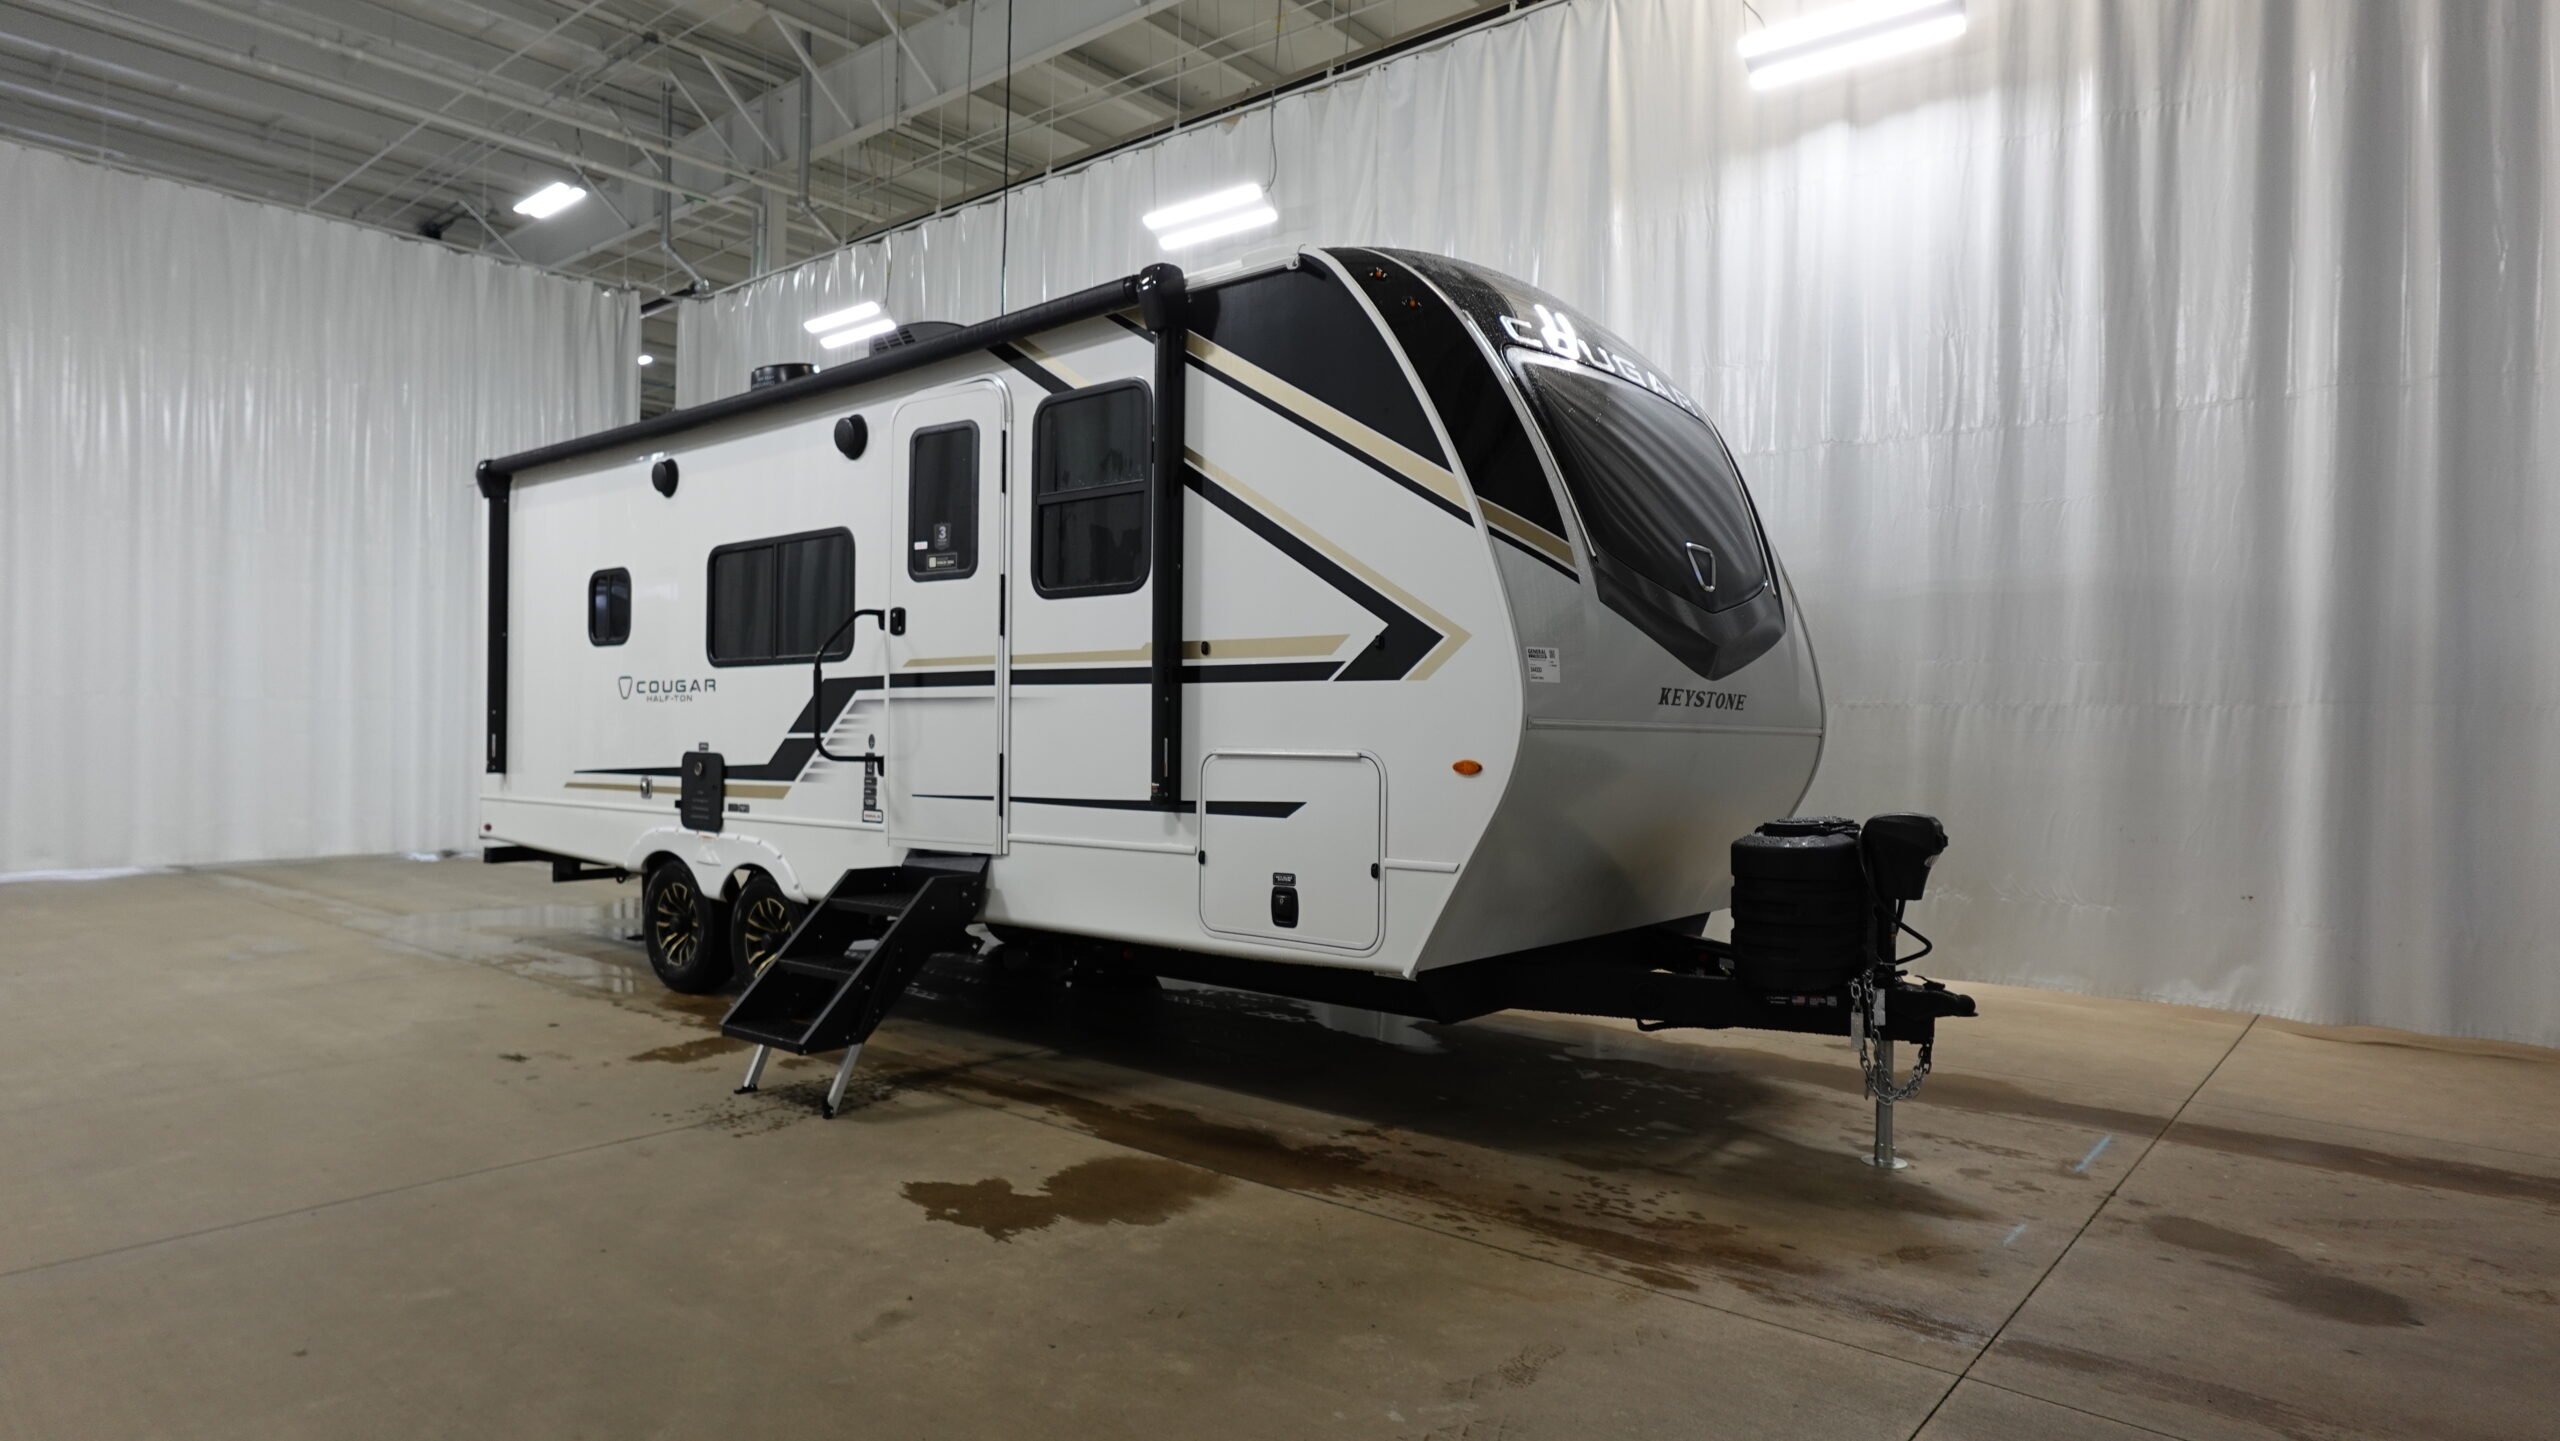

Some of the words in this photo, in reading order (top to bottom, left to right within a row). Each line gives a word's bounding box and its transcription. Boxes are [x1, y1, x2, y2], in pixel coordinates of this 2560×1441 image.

[636, 679, 716, 693] COUGAR
[646, 694, 693, 702] HALF-TON
[1658, 687, 1747, 711] KEYSTONE
